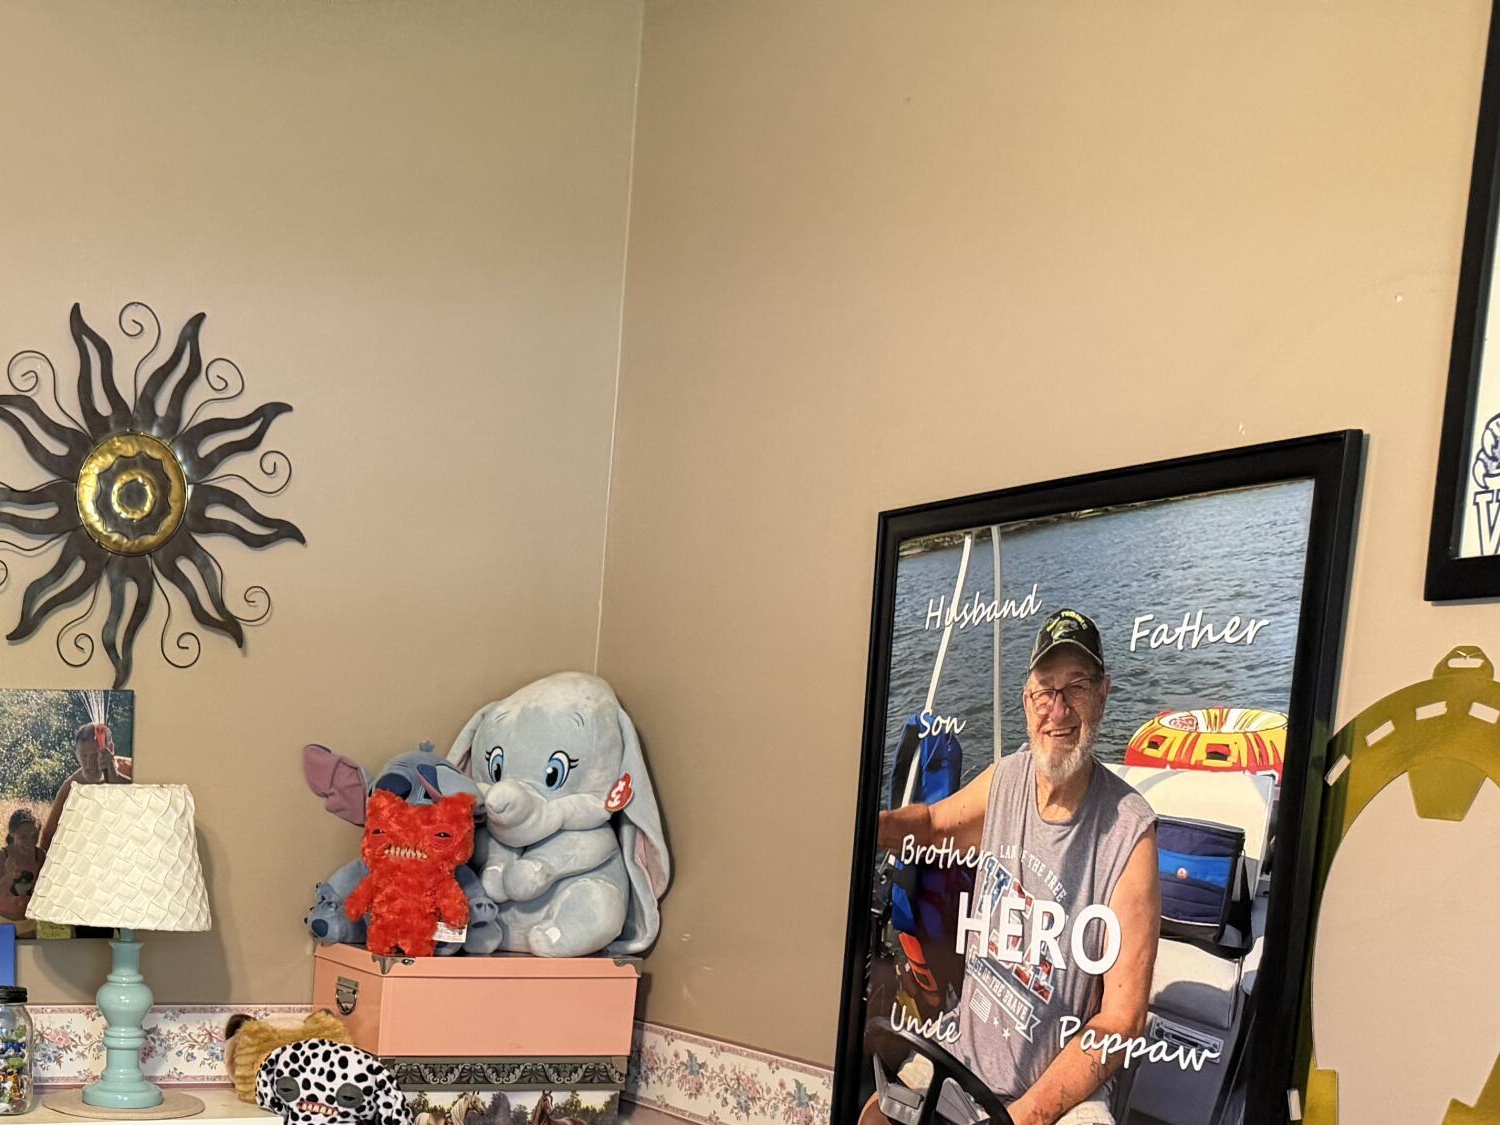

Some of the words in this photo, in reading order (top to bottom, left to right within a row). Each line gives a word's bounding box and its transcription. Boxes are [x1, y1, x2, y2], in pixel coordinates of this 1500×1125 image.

[925, 584, 1042, 631] Husband
[1130, 610, 1270, 652] Father
[918, 711, 966, 739] Son
[901, 834, 994, 871] Brother
[1027, 853, 1046, 877] THE
[1044, 870, 1068, 902] FREE
[956, 890, 1122, 975] HERO
[890, 1001, 961, 1044] Uncle
[1059, 1016, 1220, 1071] Pappaw
